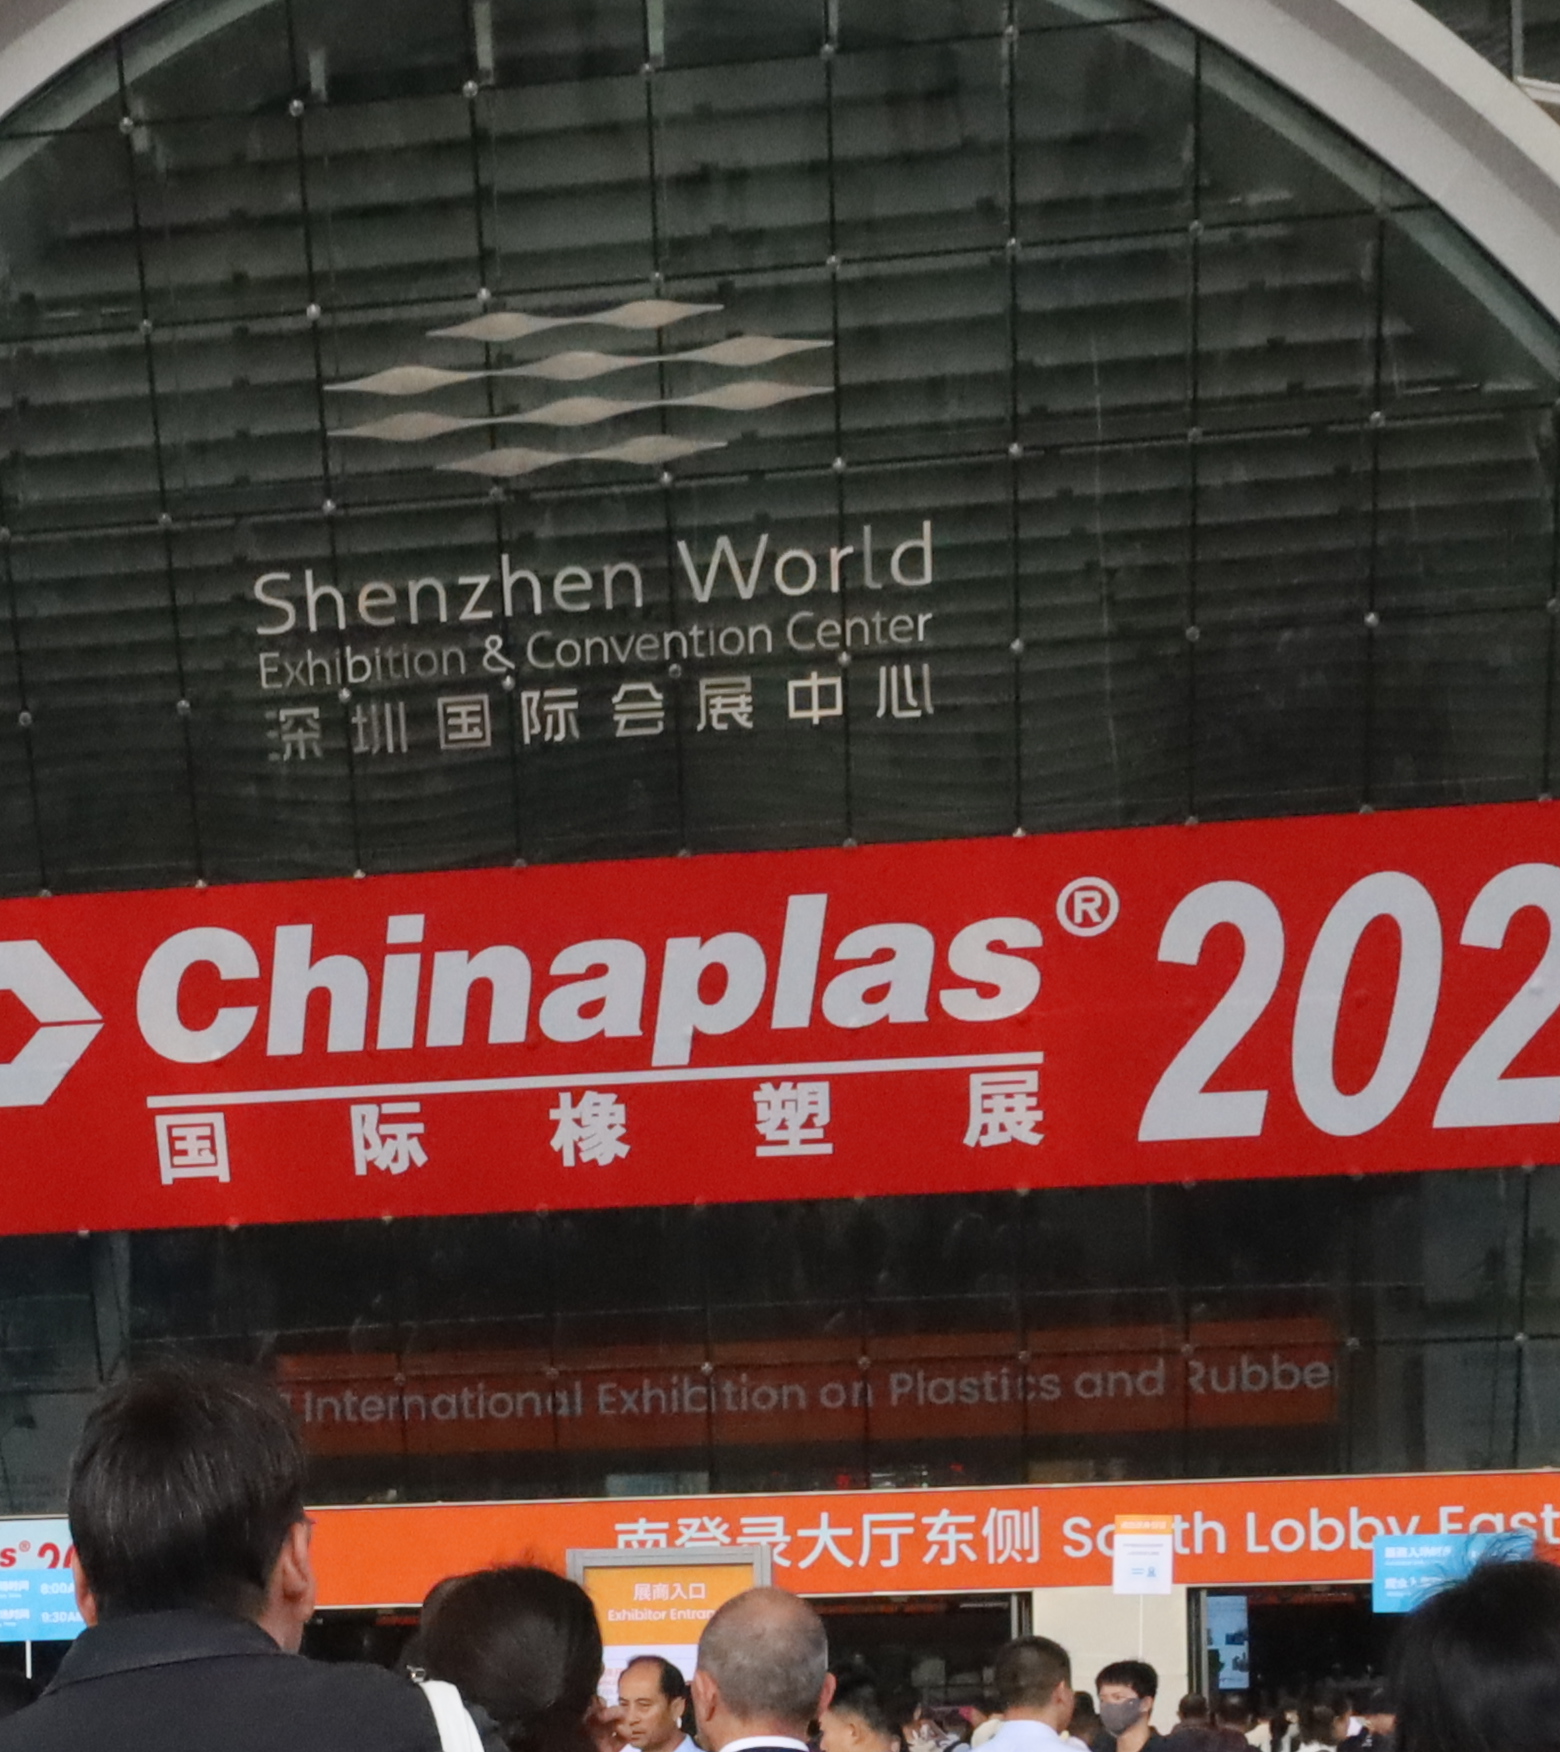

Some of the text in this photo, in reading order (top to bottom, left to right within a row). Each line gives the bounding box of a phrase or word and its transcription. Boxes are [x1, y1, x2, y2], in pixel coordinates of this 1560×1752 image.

[253, 519, 934, 636] Shenzhen World
[259, 608, 932, 691] Exhibition & Convention Center
[266, 663, 935, 761] 深圳国际会展中心
[154, 1070, 1045, 1186] 国际橡塑展
[304, 1353, 1339, 1423] International Exhibition on Plastics and Rubbe
[1062, 1510, 1227, 1558] Soth
[607, 1607, 717, 1622] Exhibitor Entran
[633, 1582, 707, 1602] 展商入口
